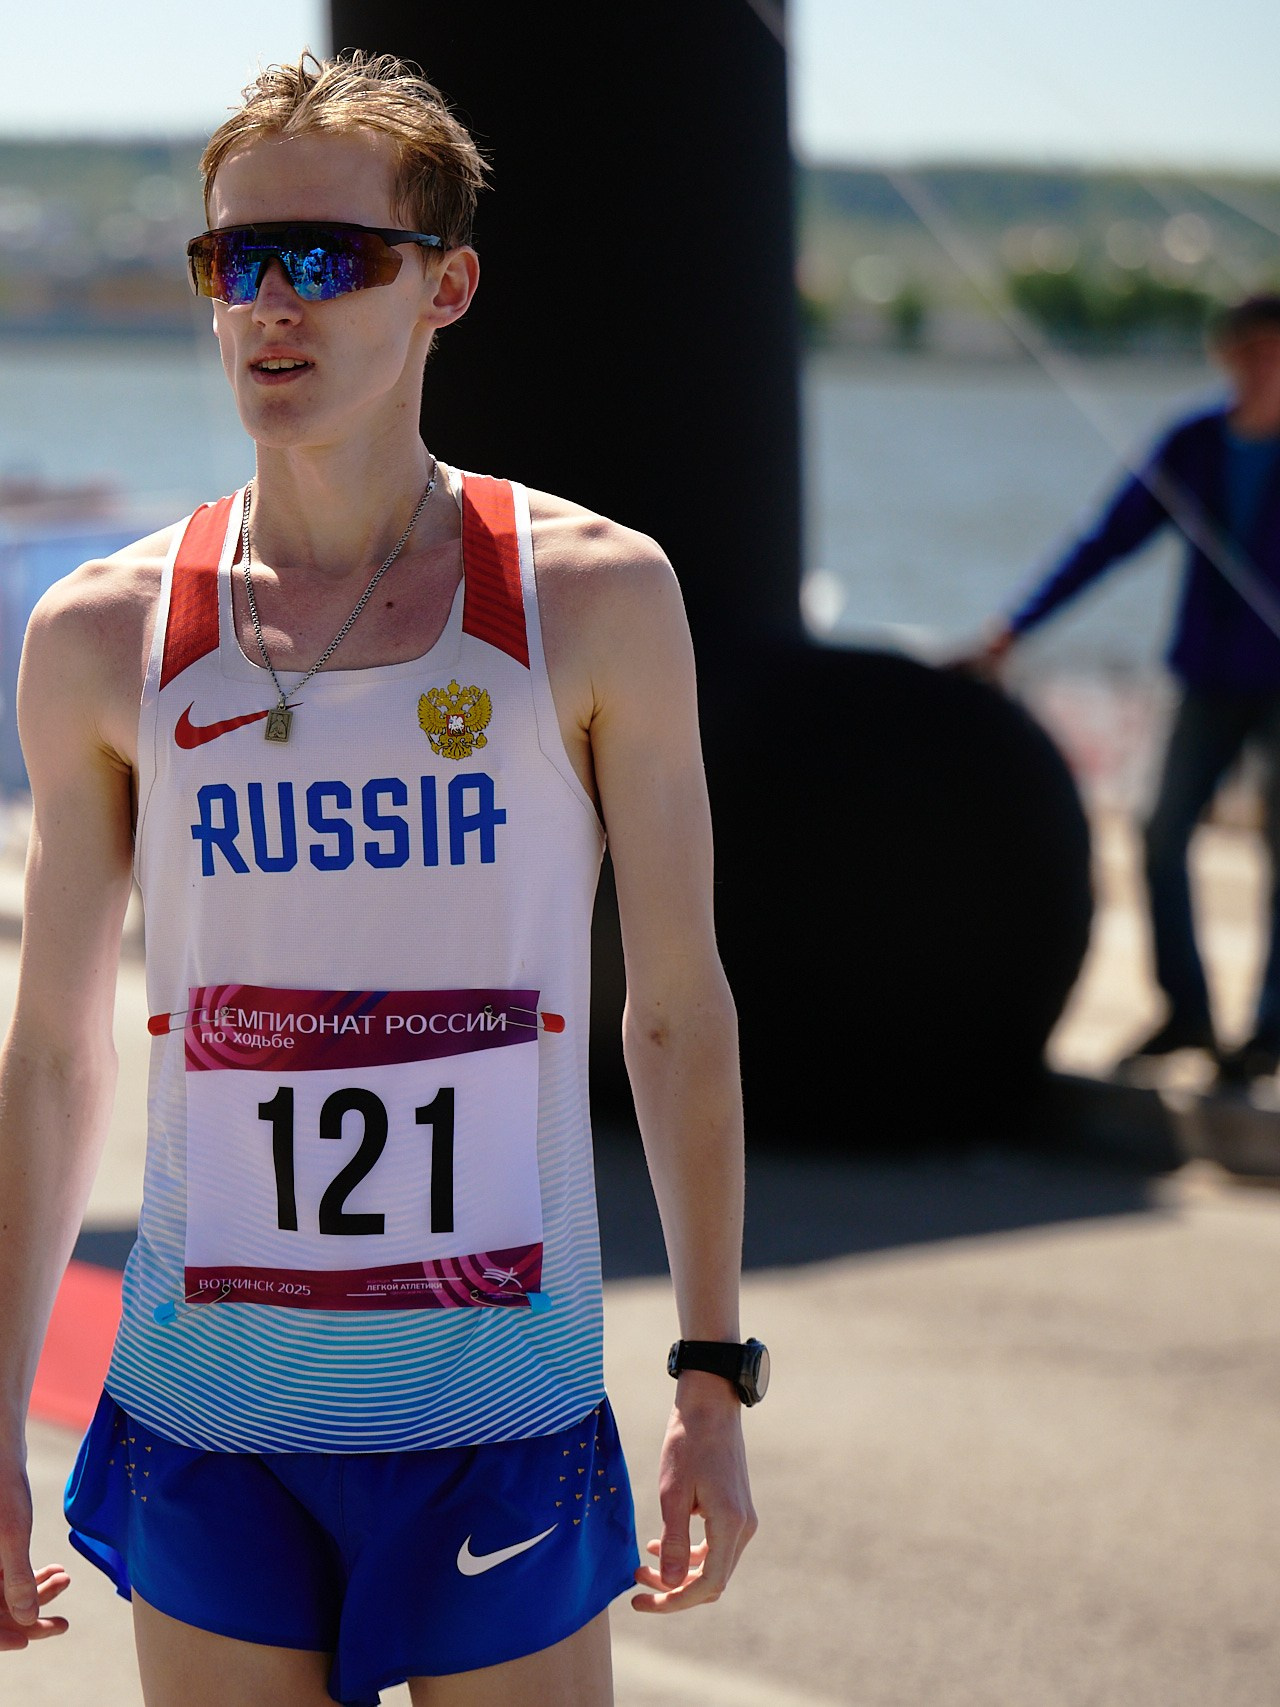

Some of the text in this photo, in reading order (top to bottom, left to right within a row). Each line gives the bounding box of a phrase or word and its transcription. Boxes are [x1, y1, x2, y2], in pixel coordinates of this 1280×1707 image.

[190, 772, 507, 877] RUSSIA
[202, 1008, 507, 1035] ЧЕМПИОНАТ РОССИИ
[201, 1032, 295, 1049] по ходьбе
[258, 1086, 455, 1236] 121
[199, 1278, 311, 1296] ВОТКИНСК 2025
[366, 1282, 399, 1292] ЛЕГКОЙ
[400, 1281, 443, 1291] АТЛЕТИКИ
